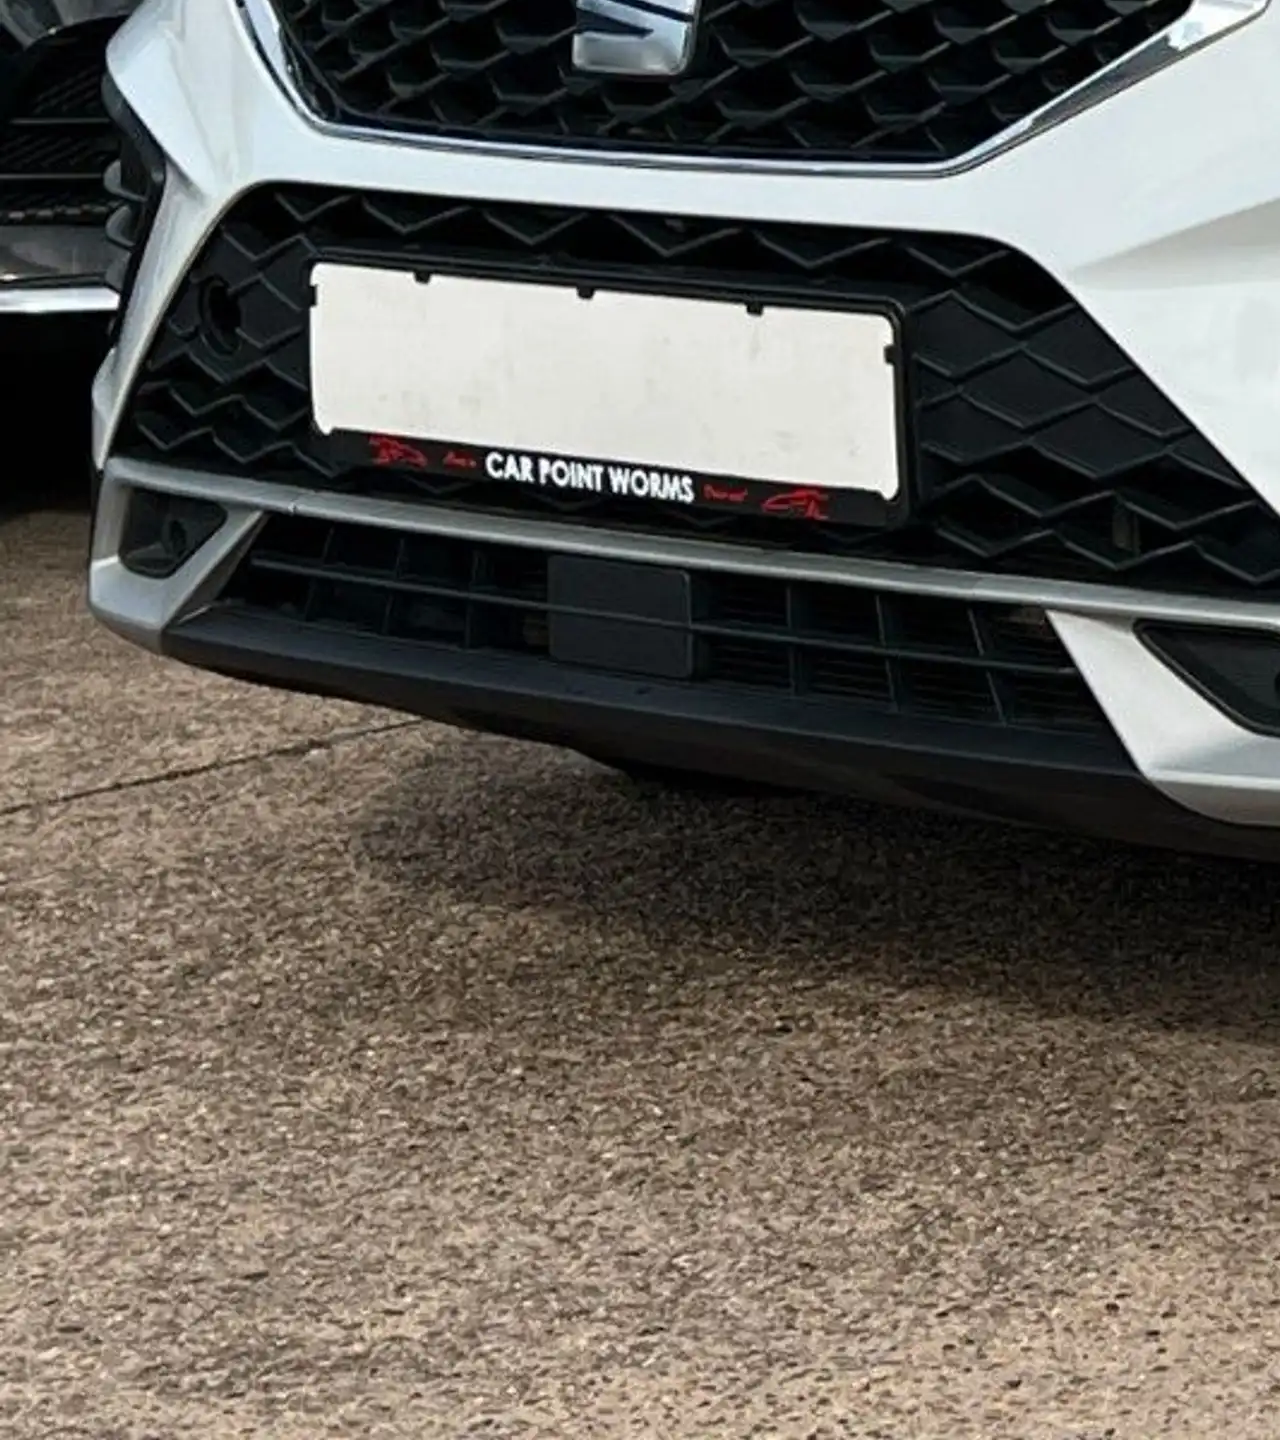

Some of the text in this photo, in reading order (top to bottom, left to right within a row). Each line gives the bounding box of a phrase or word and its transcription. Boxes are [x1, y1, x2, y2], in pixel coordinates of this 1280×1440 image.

[484, 451, 536, 484] CAR
[537, 456, 604, 492] POINT
[607, 465, 696, 505] WORMS
